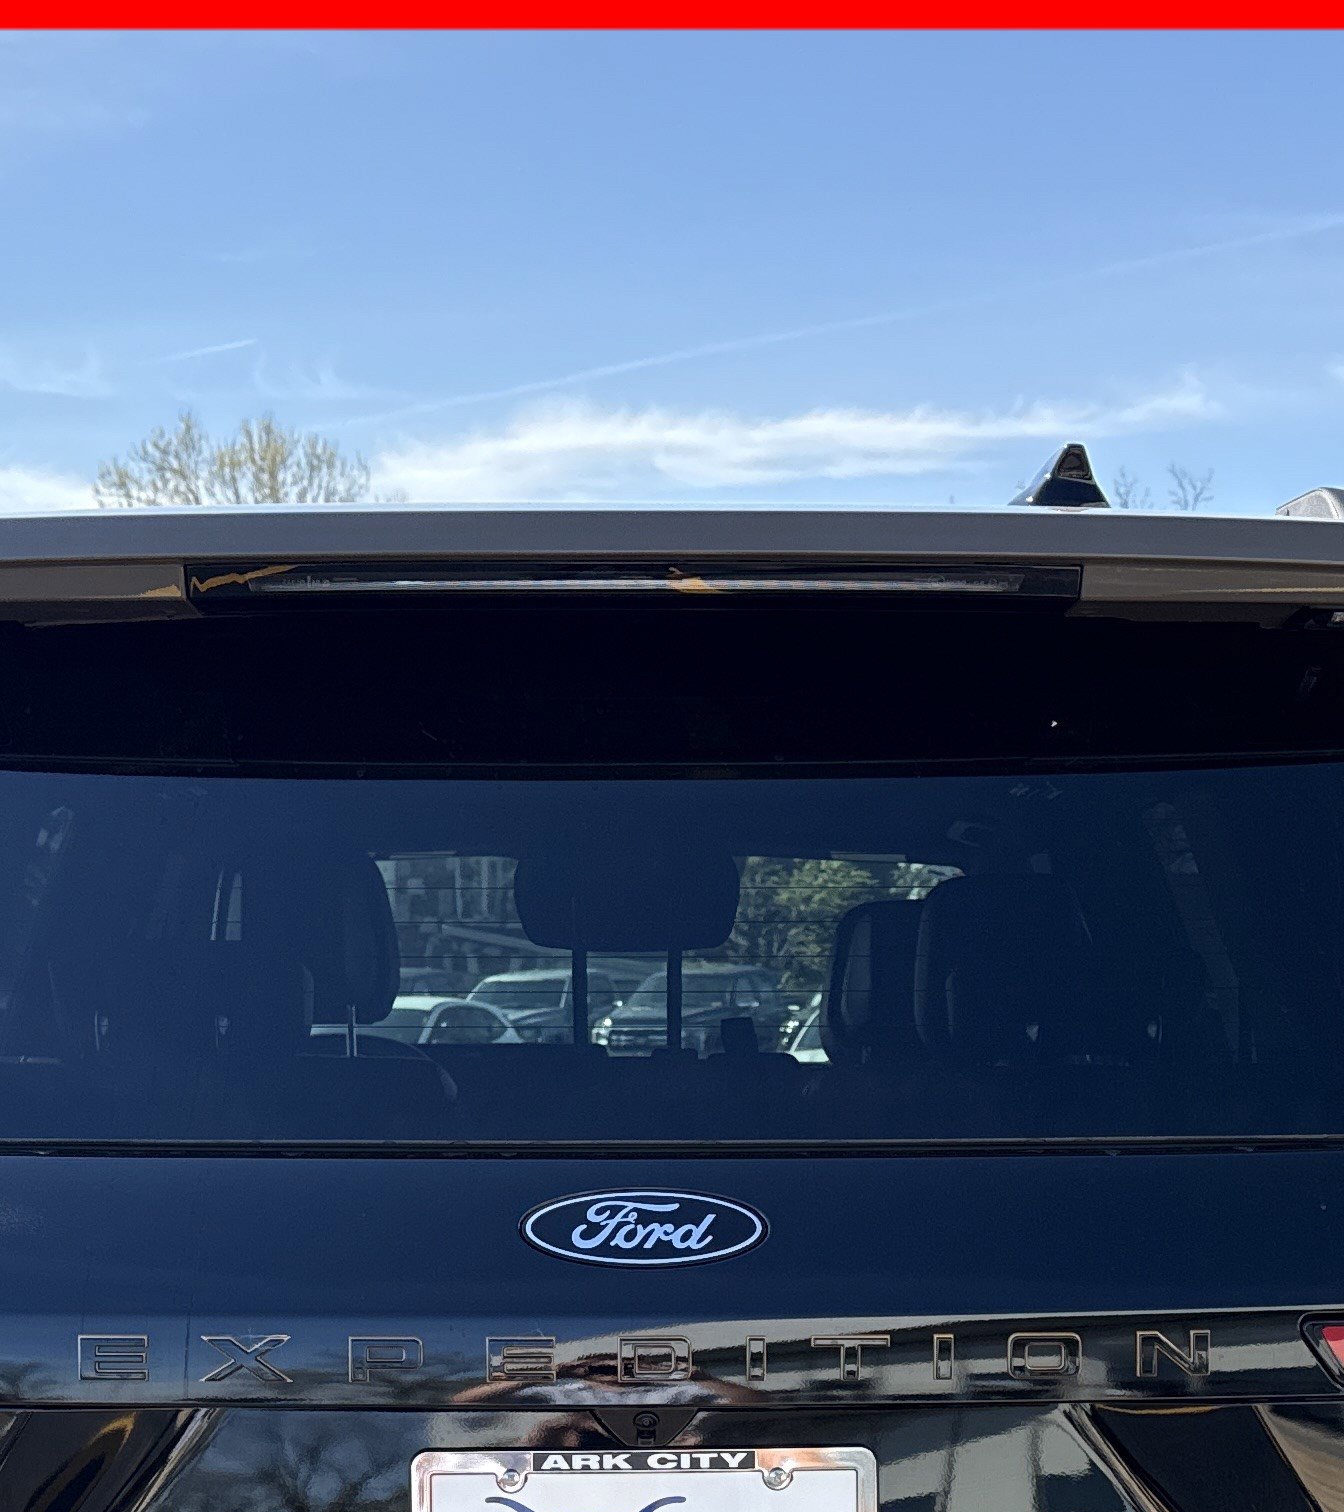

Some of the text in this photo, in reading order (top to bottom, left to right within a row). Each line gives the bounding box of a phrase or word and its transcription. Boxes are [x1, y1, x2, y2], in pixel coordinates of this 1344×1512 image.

[571, 1200, 717, 1249] Ford
[77, 1328, 1212, 1384] EXPEDITION
[540, 1452, 749, 1471] ARK CITY
